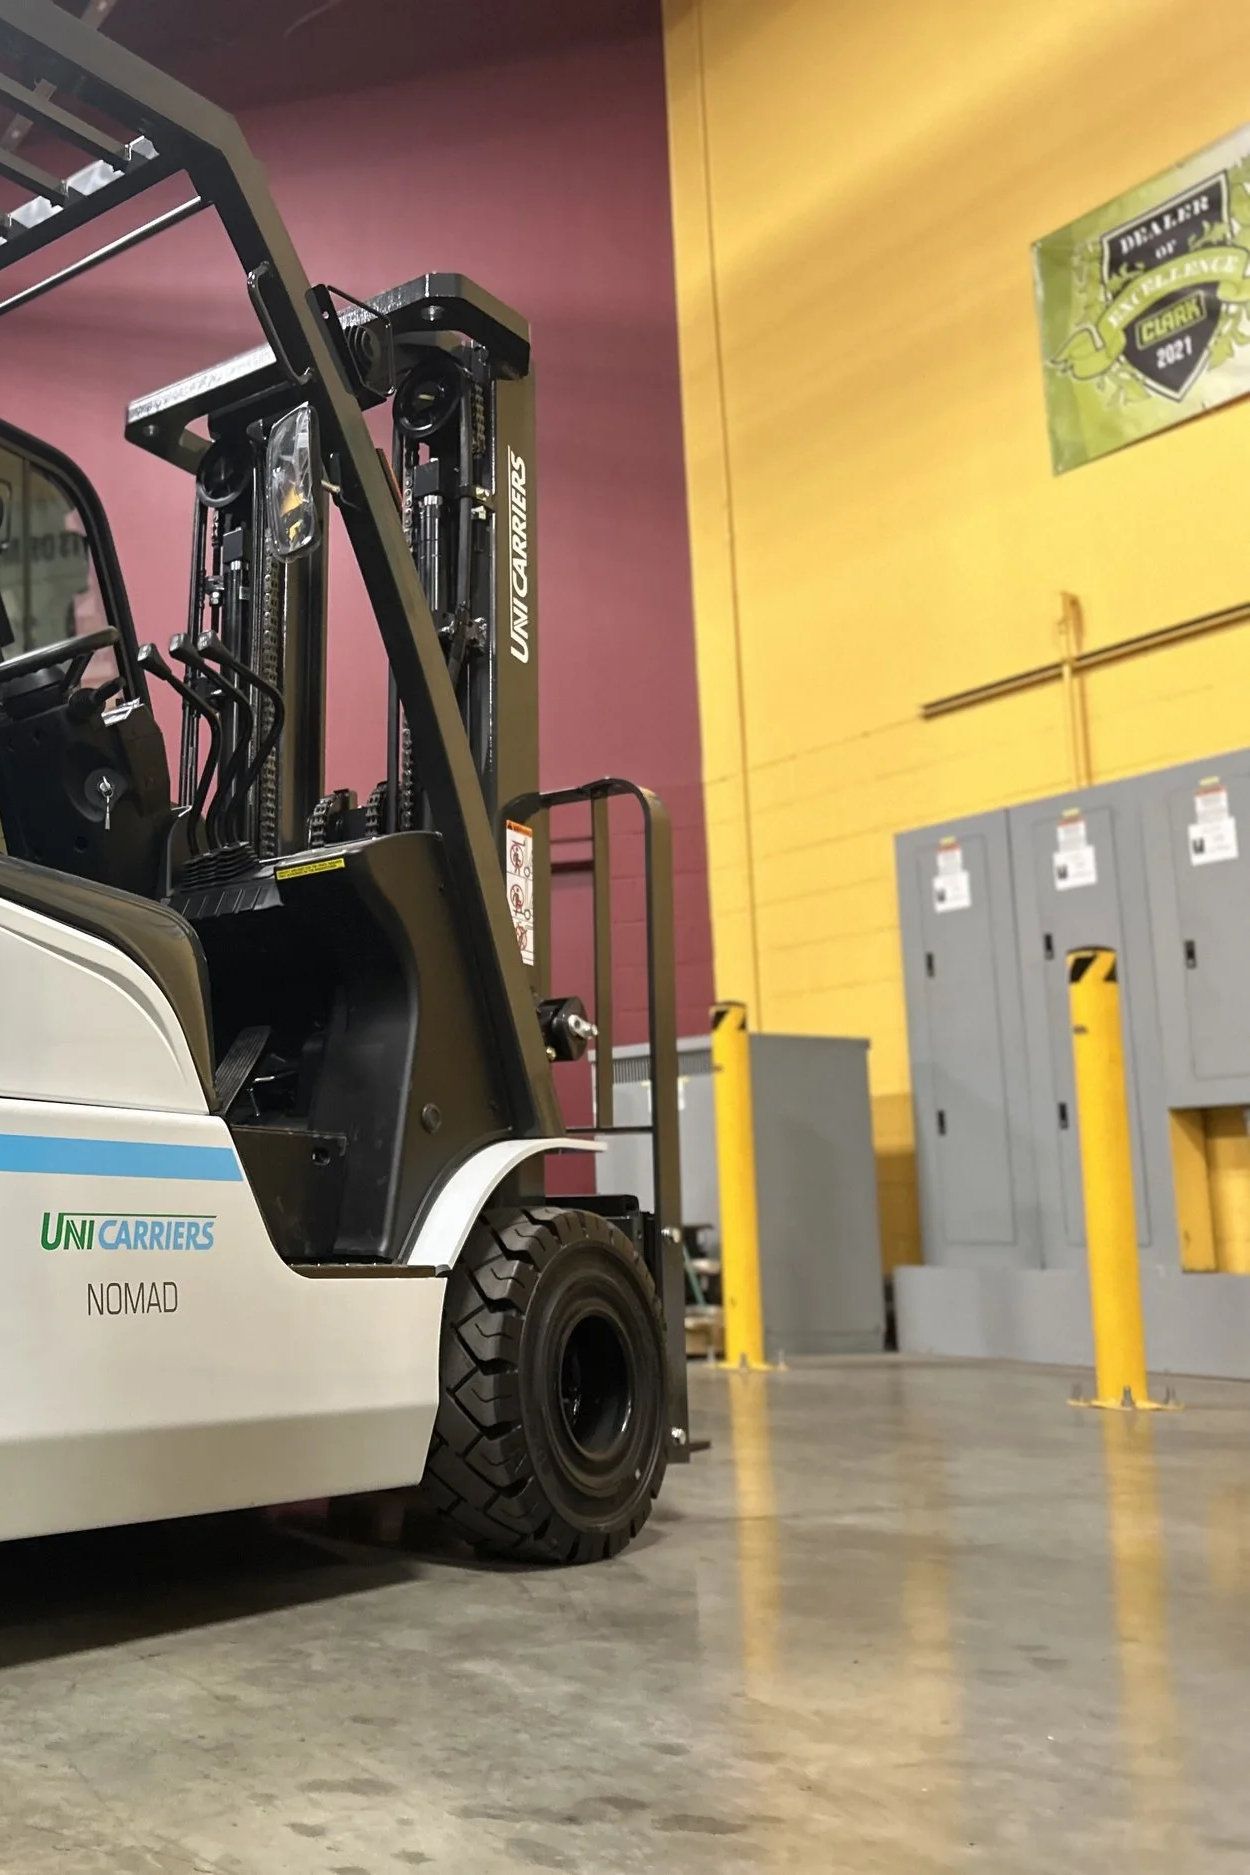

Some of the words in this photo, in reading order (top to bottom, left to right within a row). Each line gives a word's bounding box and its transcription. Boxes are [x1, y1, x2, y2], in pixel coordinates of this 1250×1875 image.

[1120, 196, 1209, 254] DEALER
[1155, 239, 1177, 259] OF
[1107, 255, 1240, 328] EXCELLENCE
[1141, 296, 1202, 342] CLARK
[1155, 335, 1193, 369] 2021
[87, 1281, 178, 1316] NOMAD
